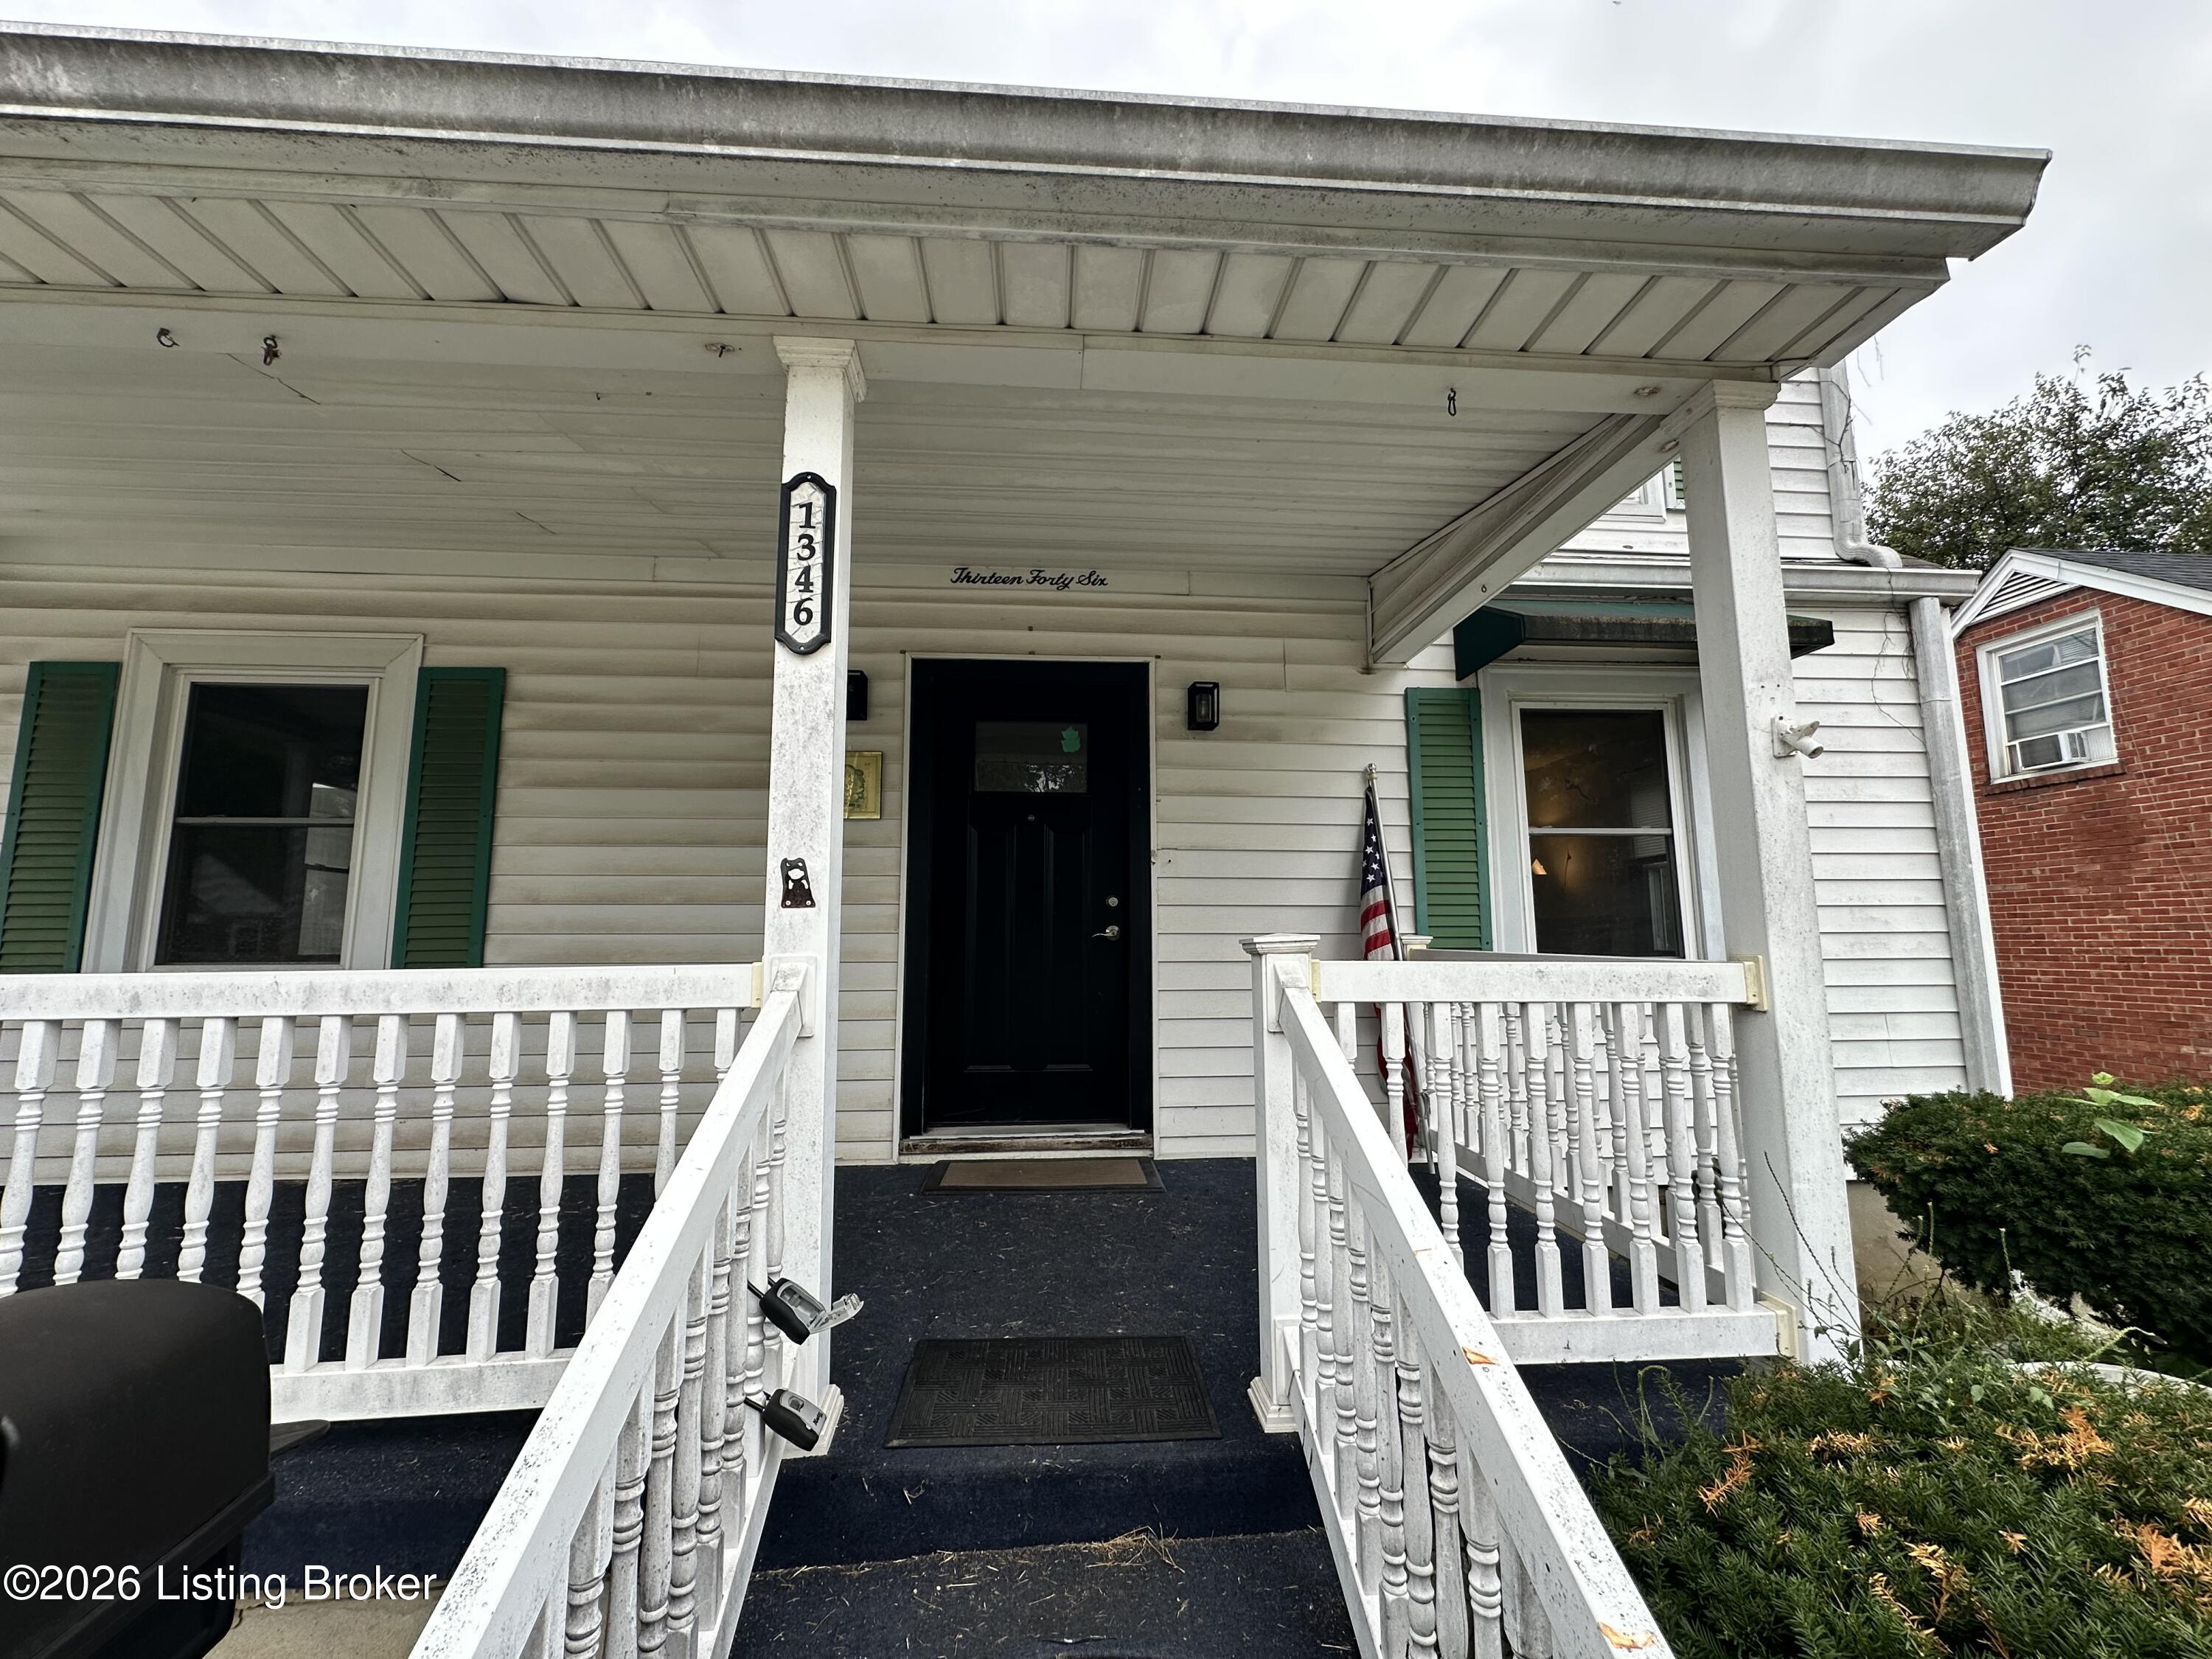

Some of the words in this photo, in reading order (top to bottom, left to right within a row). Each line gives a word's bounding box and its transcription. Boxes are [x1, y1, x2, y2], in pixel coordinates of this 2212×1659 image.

[793, 501, 816, 625] 1346
[950, 567, 1023, 585] Thirteen
[1026, 569, 1074, 591] Forty
[1075, 570, 1108, 586] Six
